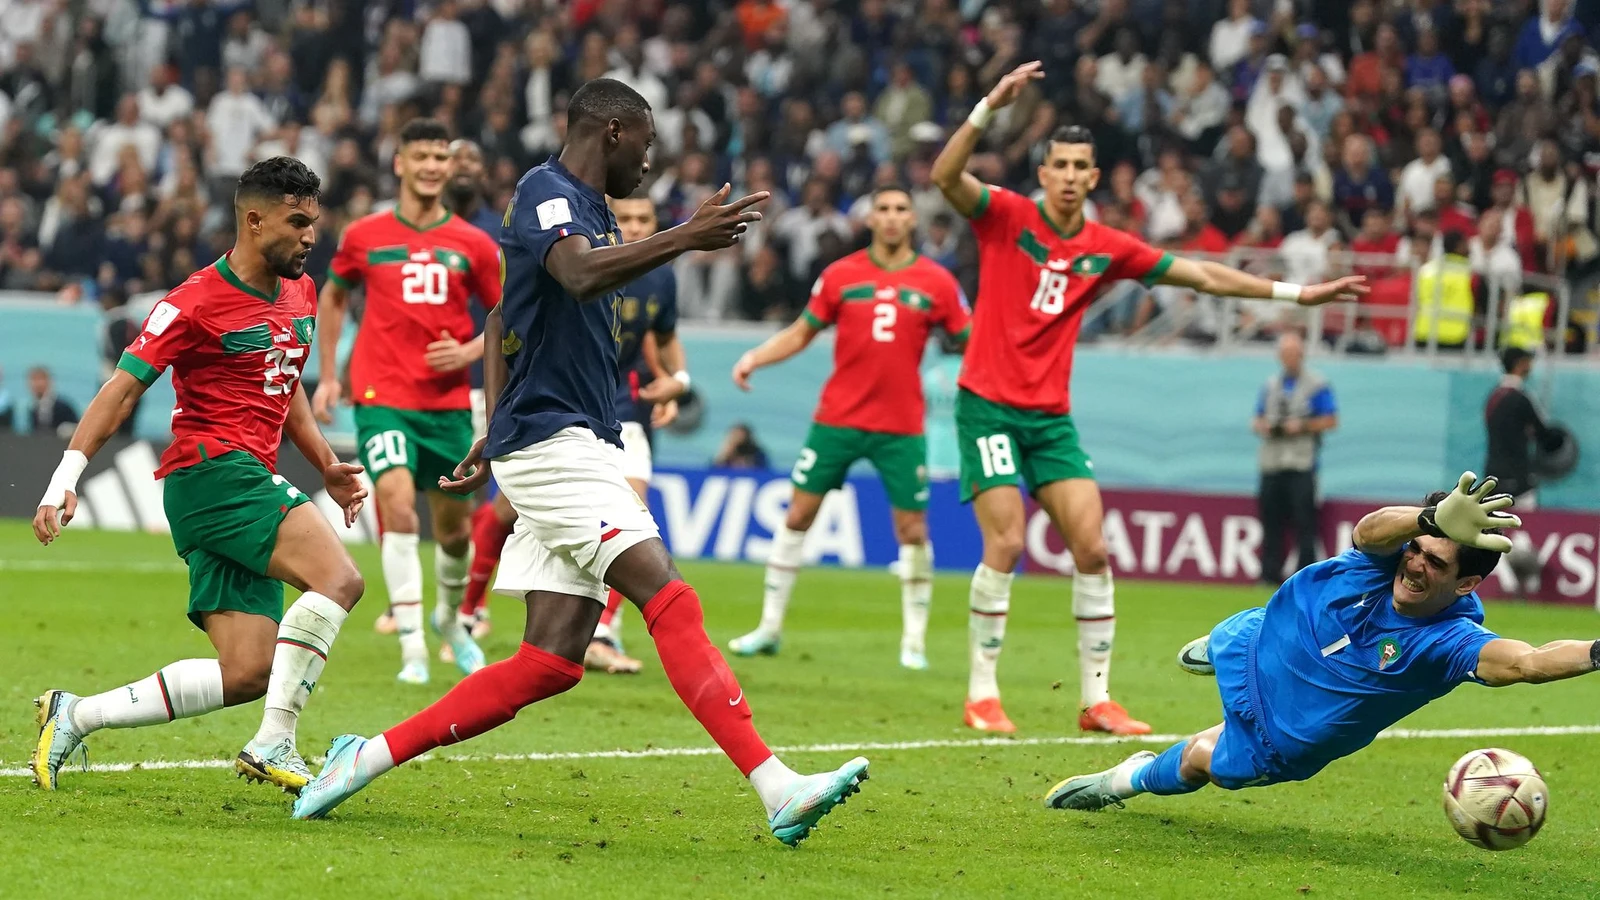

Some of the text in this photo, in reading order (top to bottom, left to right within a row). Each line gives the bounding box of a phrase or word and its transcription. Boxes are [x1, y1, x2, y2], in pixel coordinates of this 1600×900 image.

[402, 262, 448, 304] 20
[1030, 268, 1068, 315] 18
[872, 304, 896, 342] 2
[264, 348, 303, 395] 25
[368, 430, 408, 472] 20
[793, 448, 818, 483] 2
[976, 434, 1016, 476] 18
[655, 475, 864, 566] VISA
[1321, 635, 1352, 657] 1
